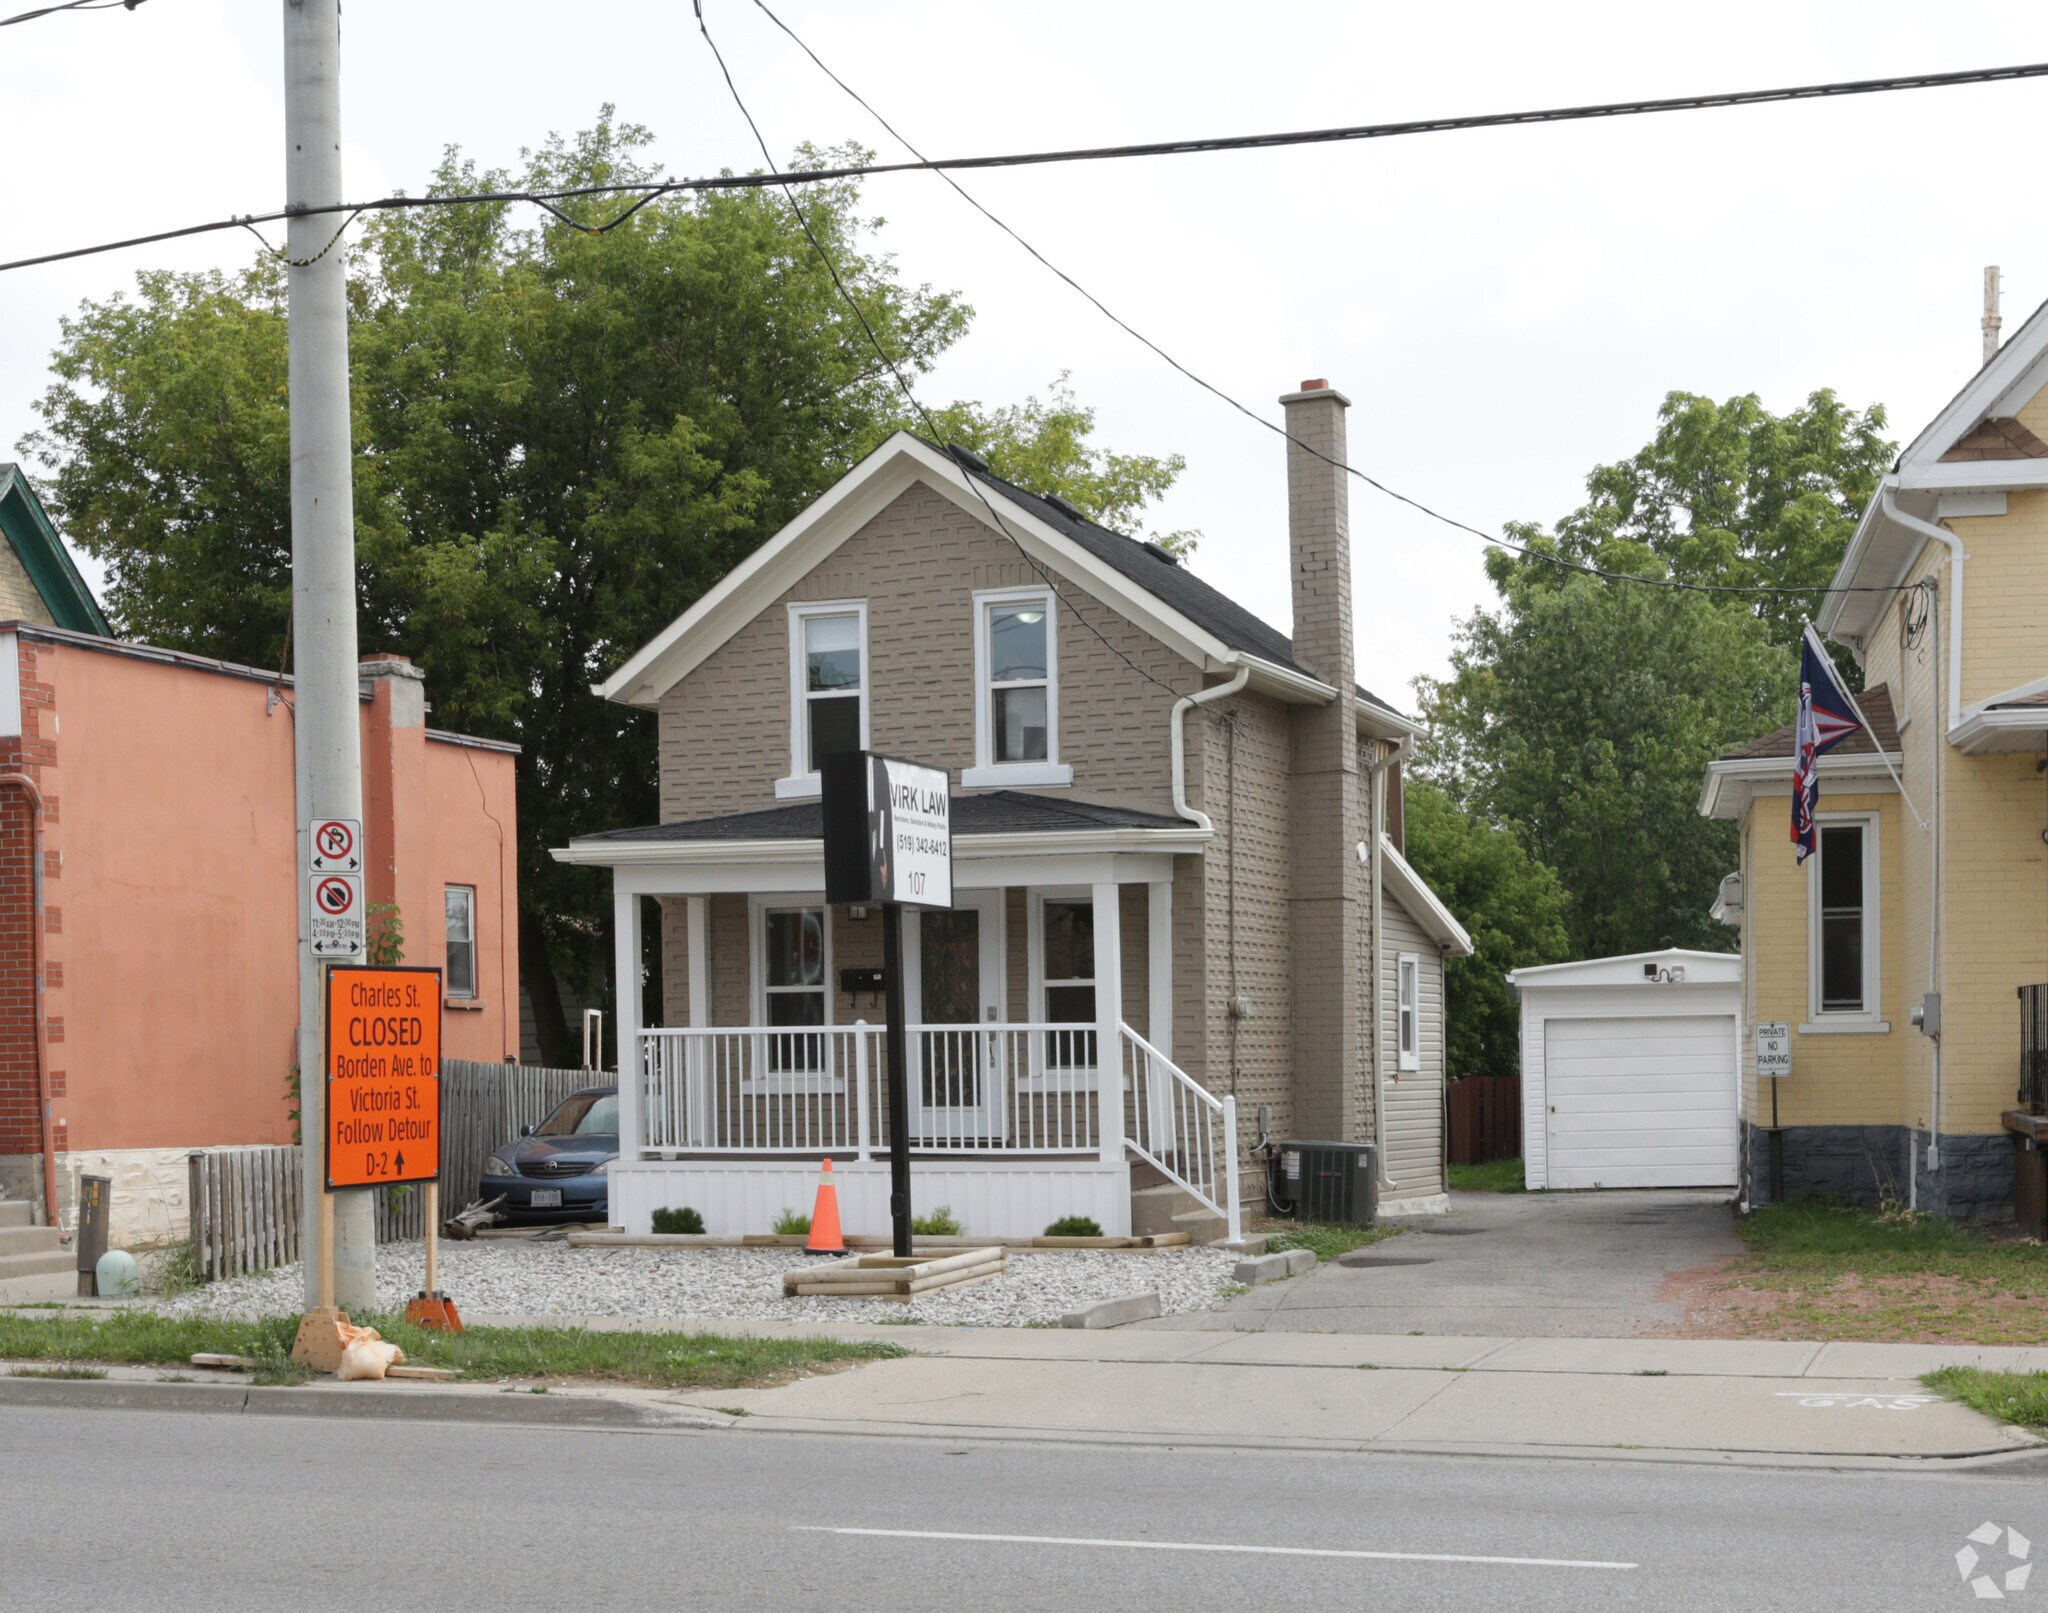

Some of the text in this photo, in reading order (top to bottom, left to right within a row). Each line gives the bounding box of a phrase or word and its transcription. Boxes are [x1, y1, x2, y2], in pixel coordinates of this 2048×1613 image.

[889, 783, 946, 816] VIRK LAW
[897, 834, 947, 857] (519) 342-6412
[908, 871, 926, 896] 107
[351, 982, 421, 1008] Charles St.
[349, 1017, 422, 1046] CLOSED
[1759, 1028, 1786, 1036] PRIVATE
[1767, 1041, 1778, 1051] NO
[337, 1053, 432, 1079] Borden Ave. to
[1758, 1055, 1789, 1065] PARKING
[350, 1085, 421, 1112] Victoria St.
[337, 1118, 432, 1145] Follow Detour
[366, 1152, 388, 1176] D-2
[1799, 1397, 1936, 1410] GAS
